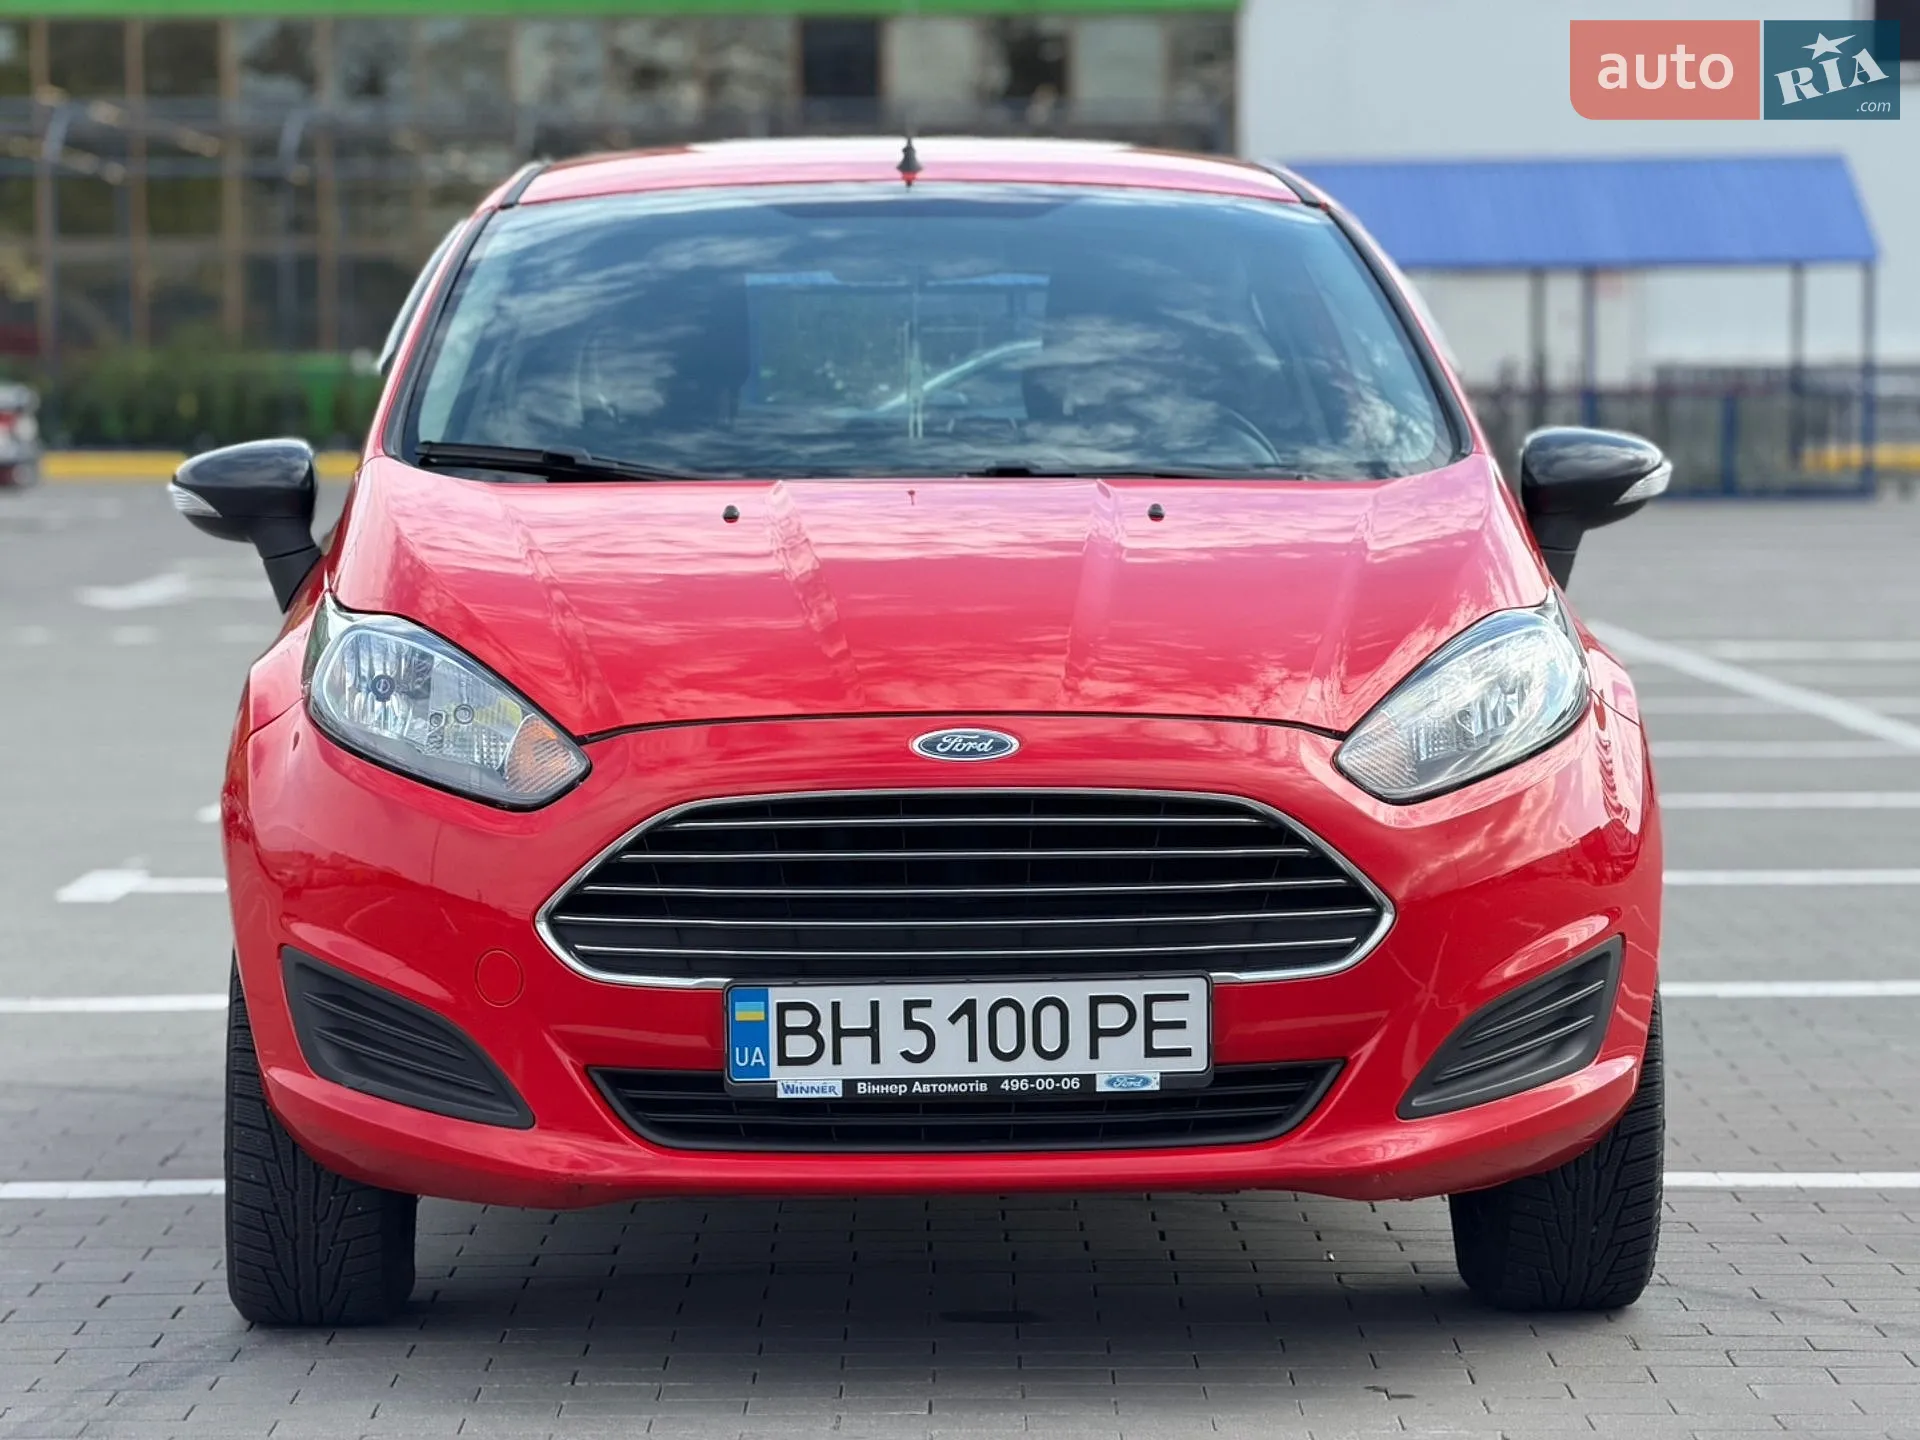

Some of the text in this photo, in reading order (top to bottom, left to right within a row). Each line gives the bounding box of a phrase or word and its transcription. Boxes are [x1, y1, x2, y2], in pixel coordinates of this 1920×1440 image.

[936, 734, 994, 753] Ford
[775, 993, 1193, 1067] BH 5100 PE
[735, 1046, 765, 1067] UA
[857, 1077, 1080, 1096] Віннер Автомотів 496-00-06
[1112, 1077, 1144, 1088] Ford
